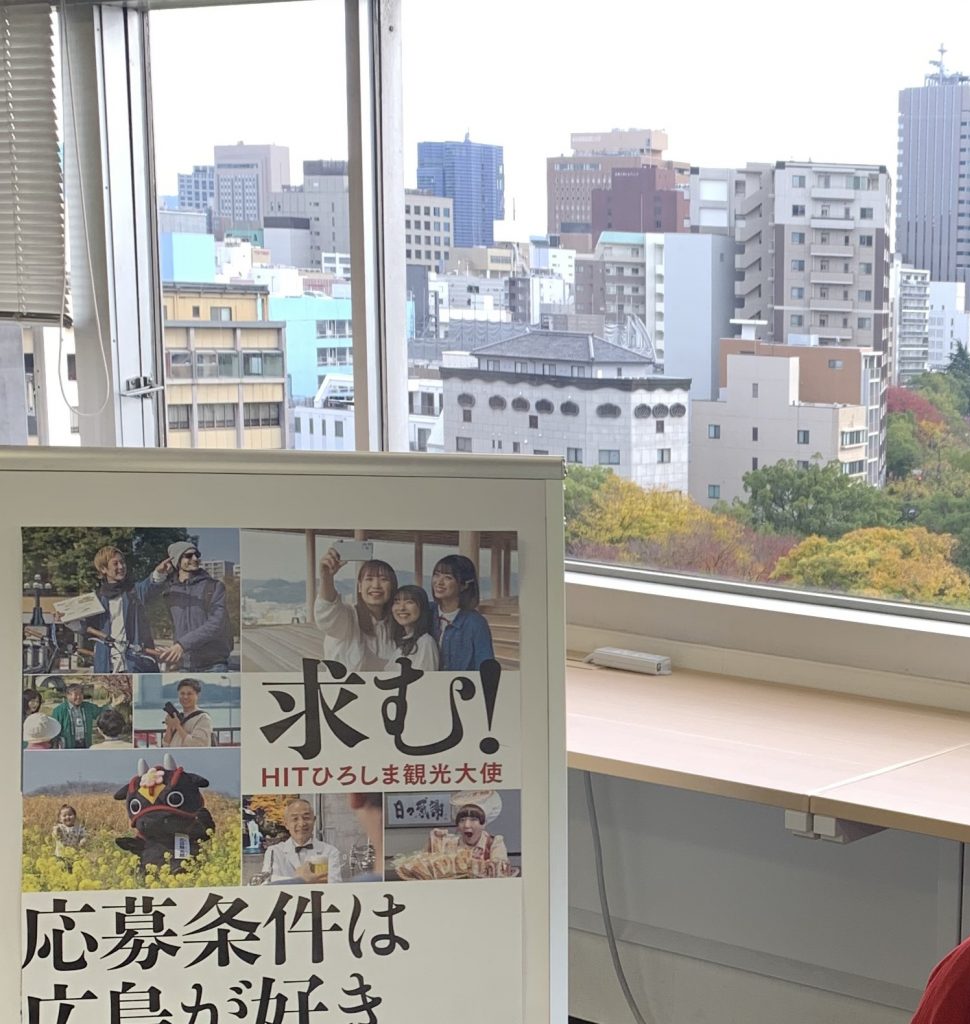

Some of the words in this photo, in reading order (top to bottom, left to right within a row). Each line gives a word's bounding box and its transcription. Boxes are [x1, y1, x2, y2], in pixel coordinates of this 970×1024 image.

[261, 762, 503, 788] HITひろしま観光大使
[21, 891, 411, 974] 応募条件は
